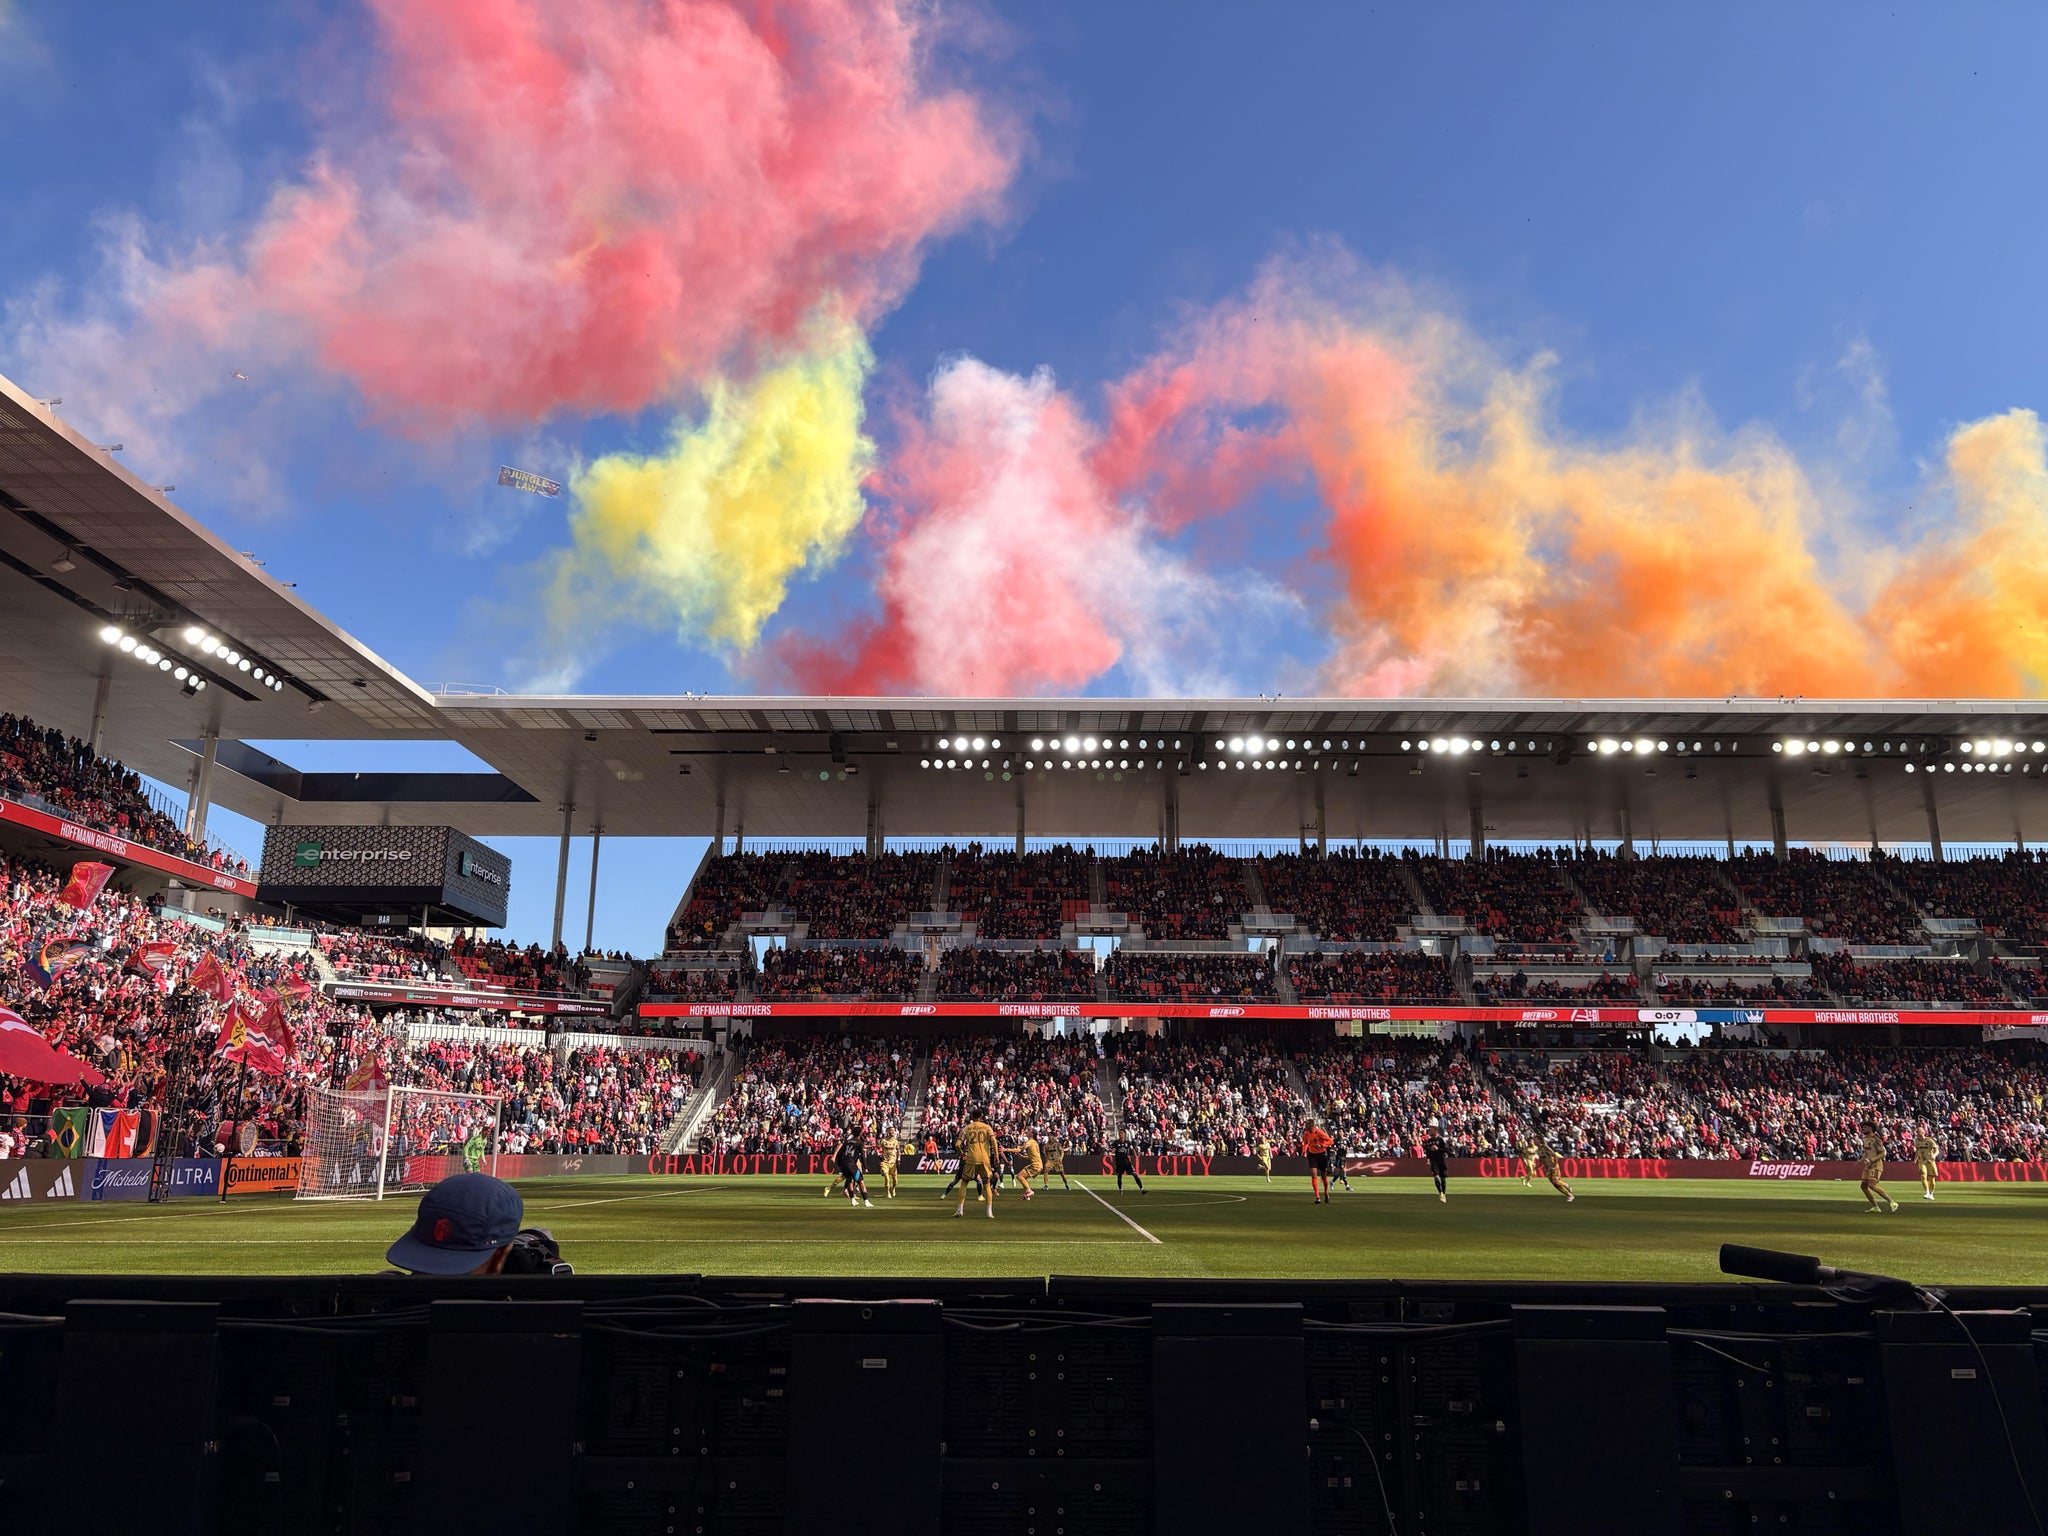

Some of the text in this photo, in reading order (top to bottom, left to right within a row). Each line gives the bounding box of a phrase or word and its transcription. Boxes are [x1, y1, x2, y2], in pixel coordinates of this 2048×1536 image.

[510, 470, 548, 488] JUNGLE
[515, 481, 537, 493] LAW
[60, 822, 127, 855] HOFFMANN BROTHERS
[300, 847, 412, 863] enterprise
[464, 860, 501, 885] enterprise
[378, 915, 390, 924] BAR
[335, 987, 363, 997] COMMUNITY
[452, 996, 478, 1005] COMMUNITY
[689, 1005, 771, 1016] HOFFMANN BROTHERS
[999, 1005, 1080, 1016] HOFFMANN BROTHERS
[1308, 1008, 1391, 1019] HOFFMANN BROTHERS
[1655, 1012, 1681, 1020] 0:07
[1815, 1012, 1899, 1023] HOFFMANN BROTHERS
[969, 1130, 986, 1144] 20
[648, 1154, 836, 1175] CHARLOTTE FC
[916, 1155, 961, 1174] Enrgi
[1102, 1155, 1214, 1176] SL CITY
[1479, 1157, 1668, 1179] CHAOTTE FC
[1749, 1161, 1815, 1179] Energizer
[1938, 1161, 2048, 1182] STL CITY
[91, 1168, 150, 1190] Michelob
